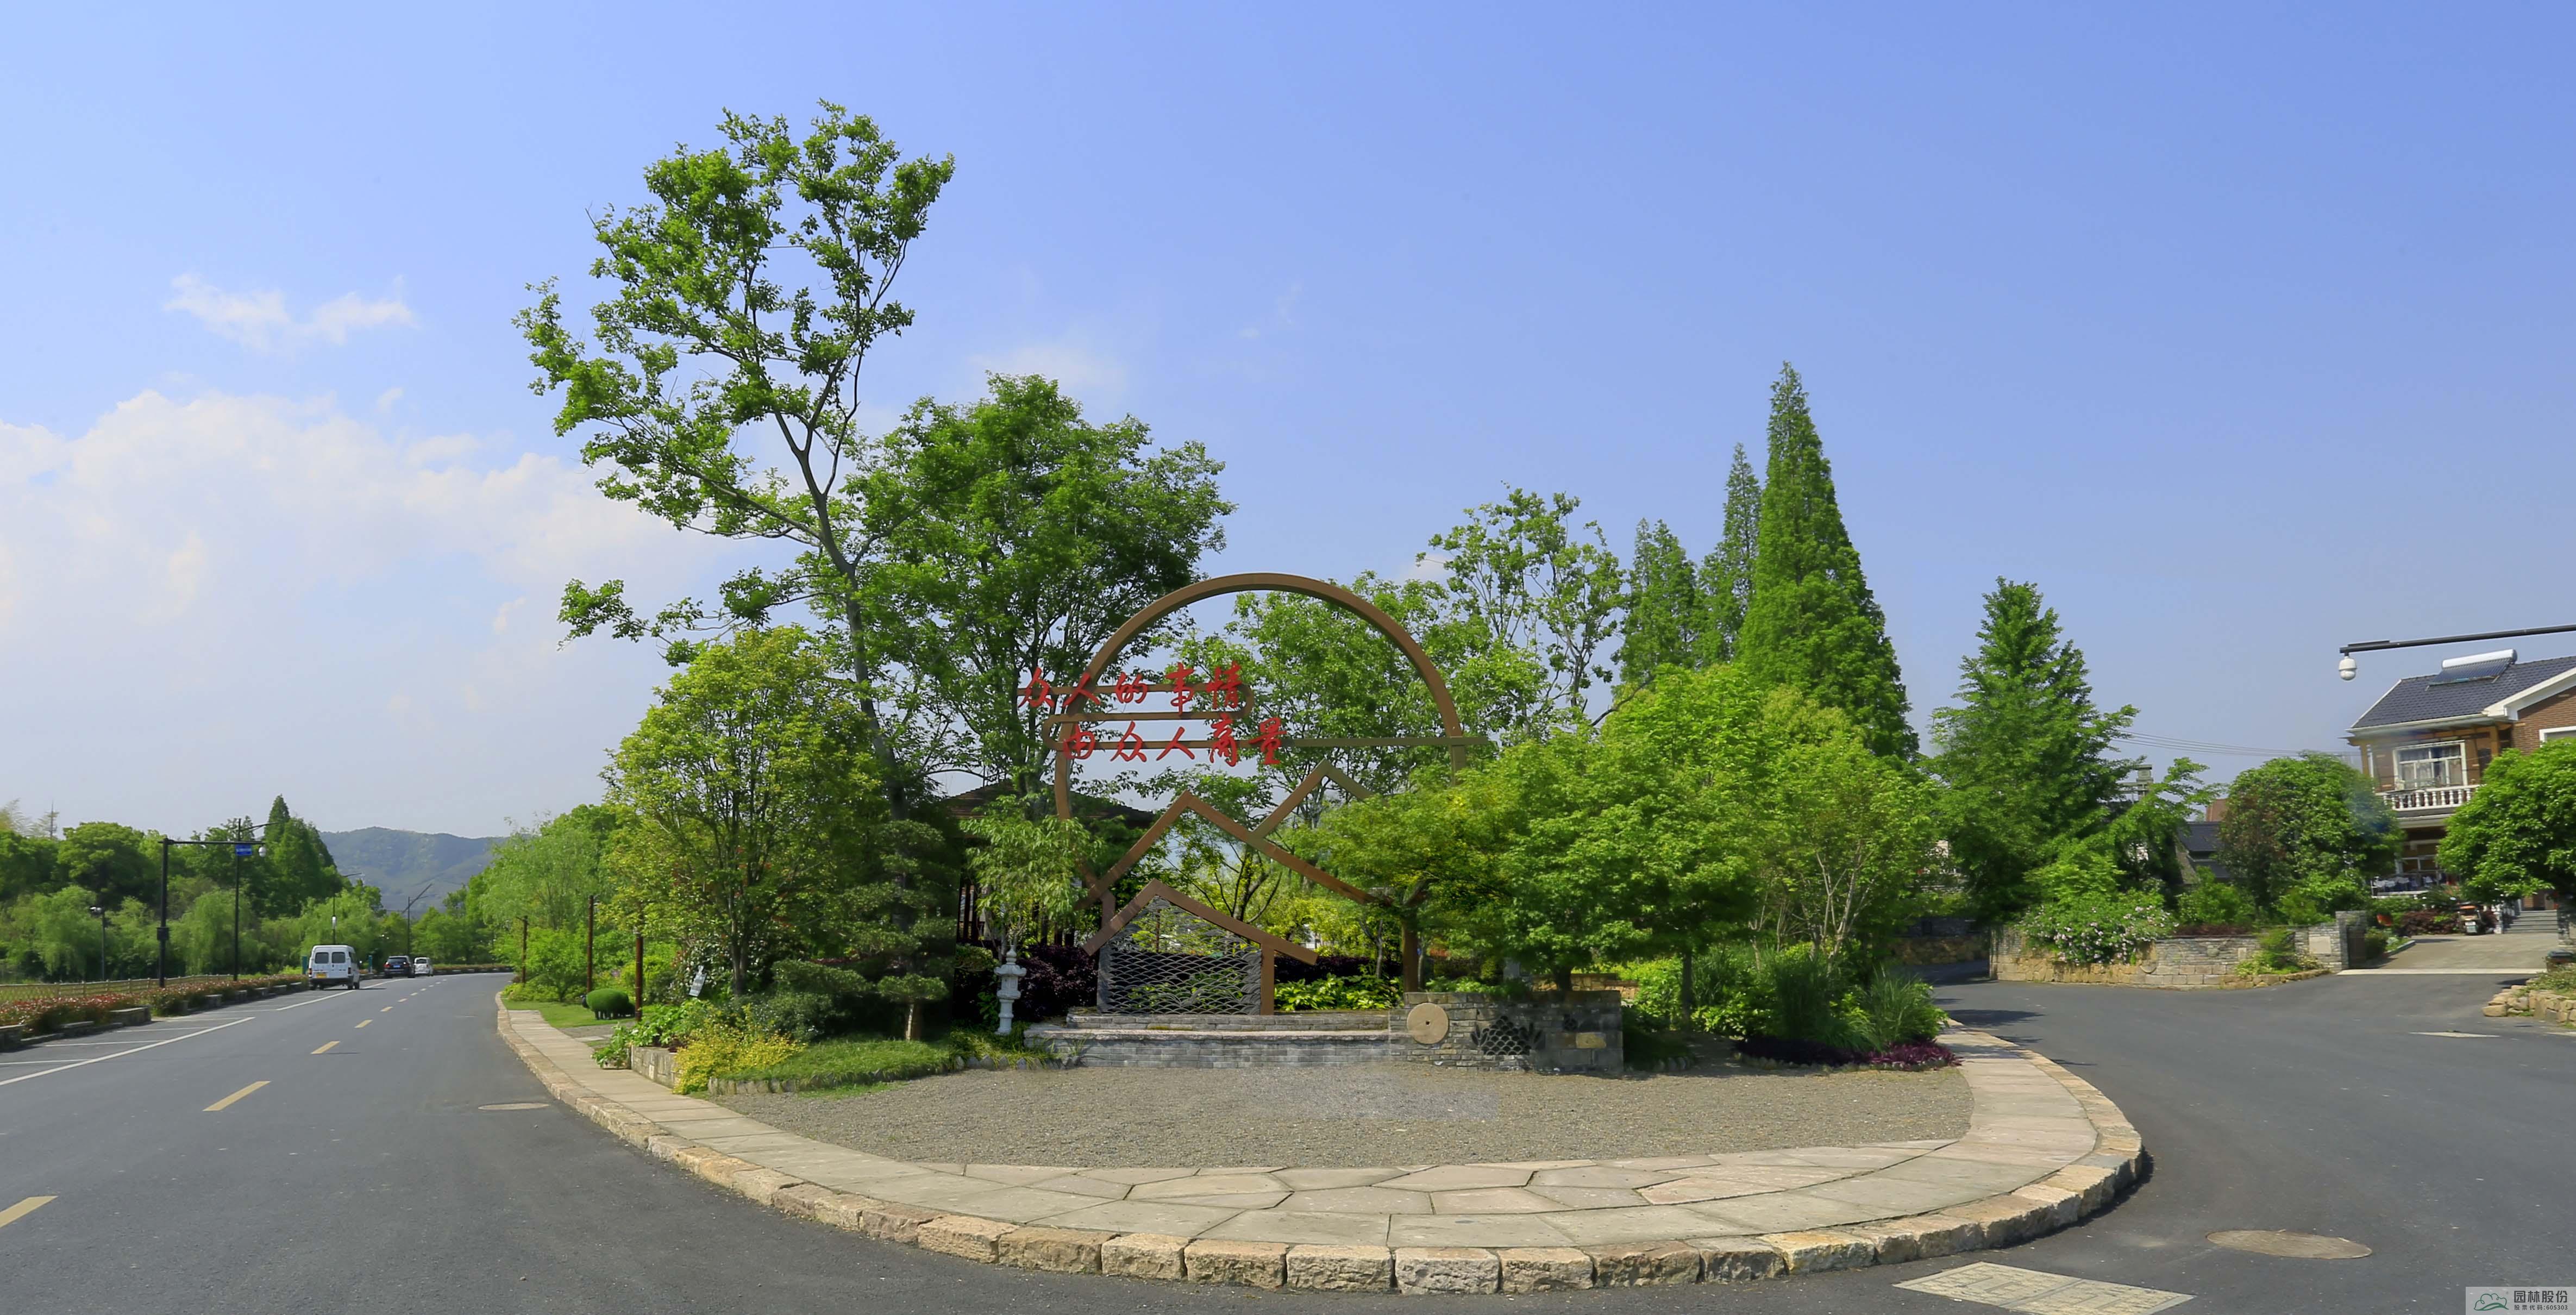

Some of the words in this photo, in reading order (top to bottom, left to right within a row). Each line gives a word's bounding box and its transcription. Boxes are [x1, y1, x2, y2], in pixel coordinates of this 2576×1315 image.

[1018, 661, 1242, 716] 众人的事情
[1063, 713, 1287, 766] 由众人商量
